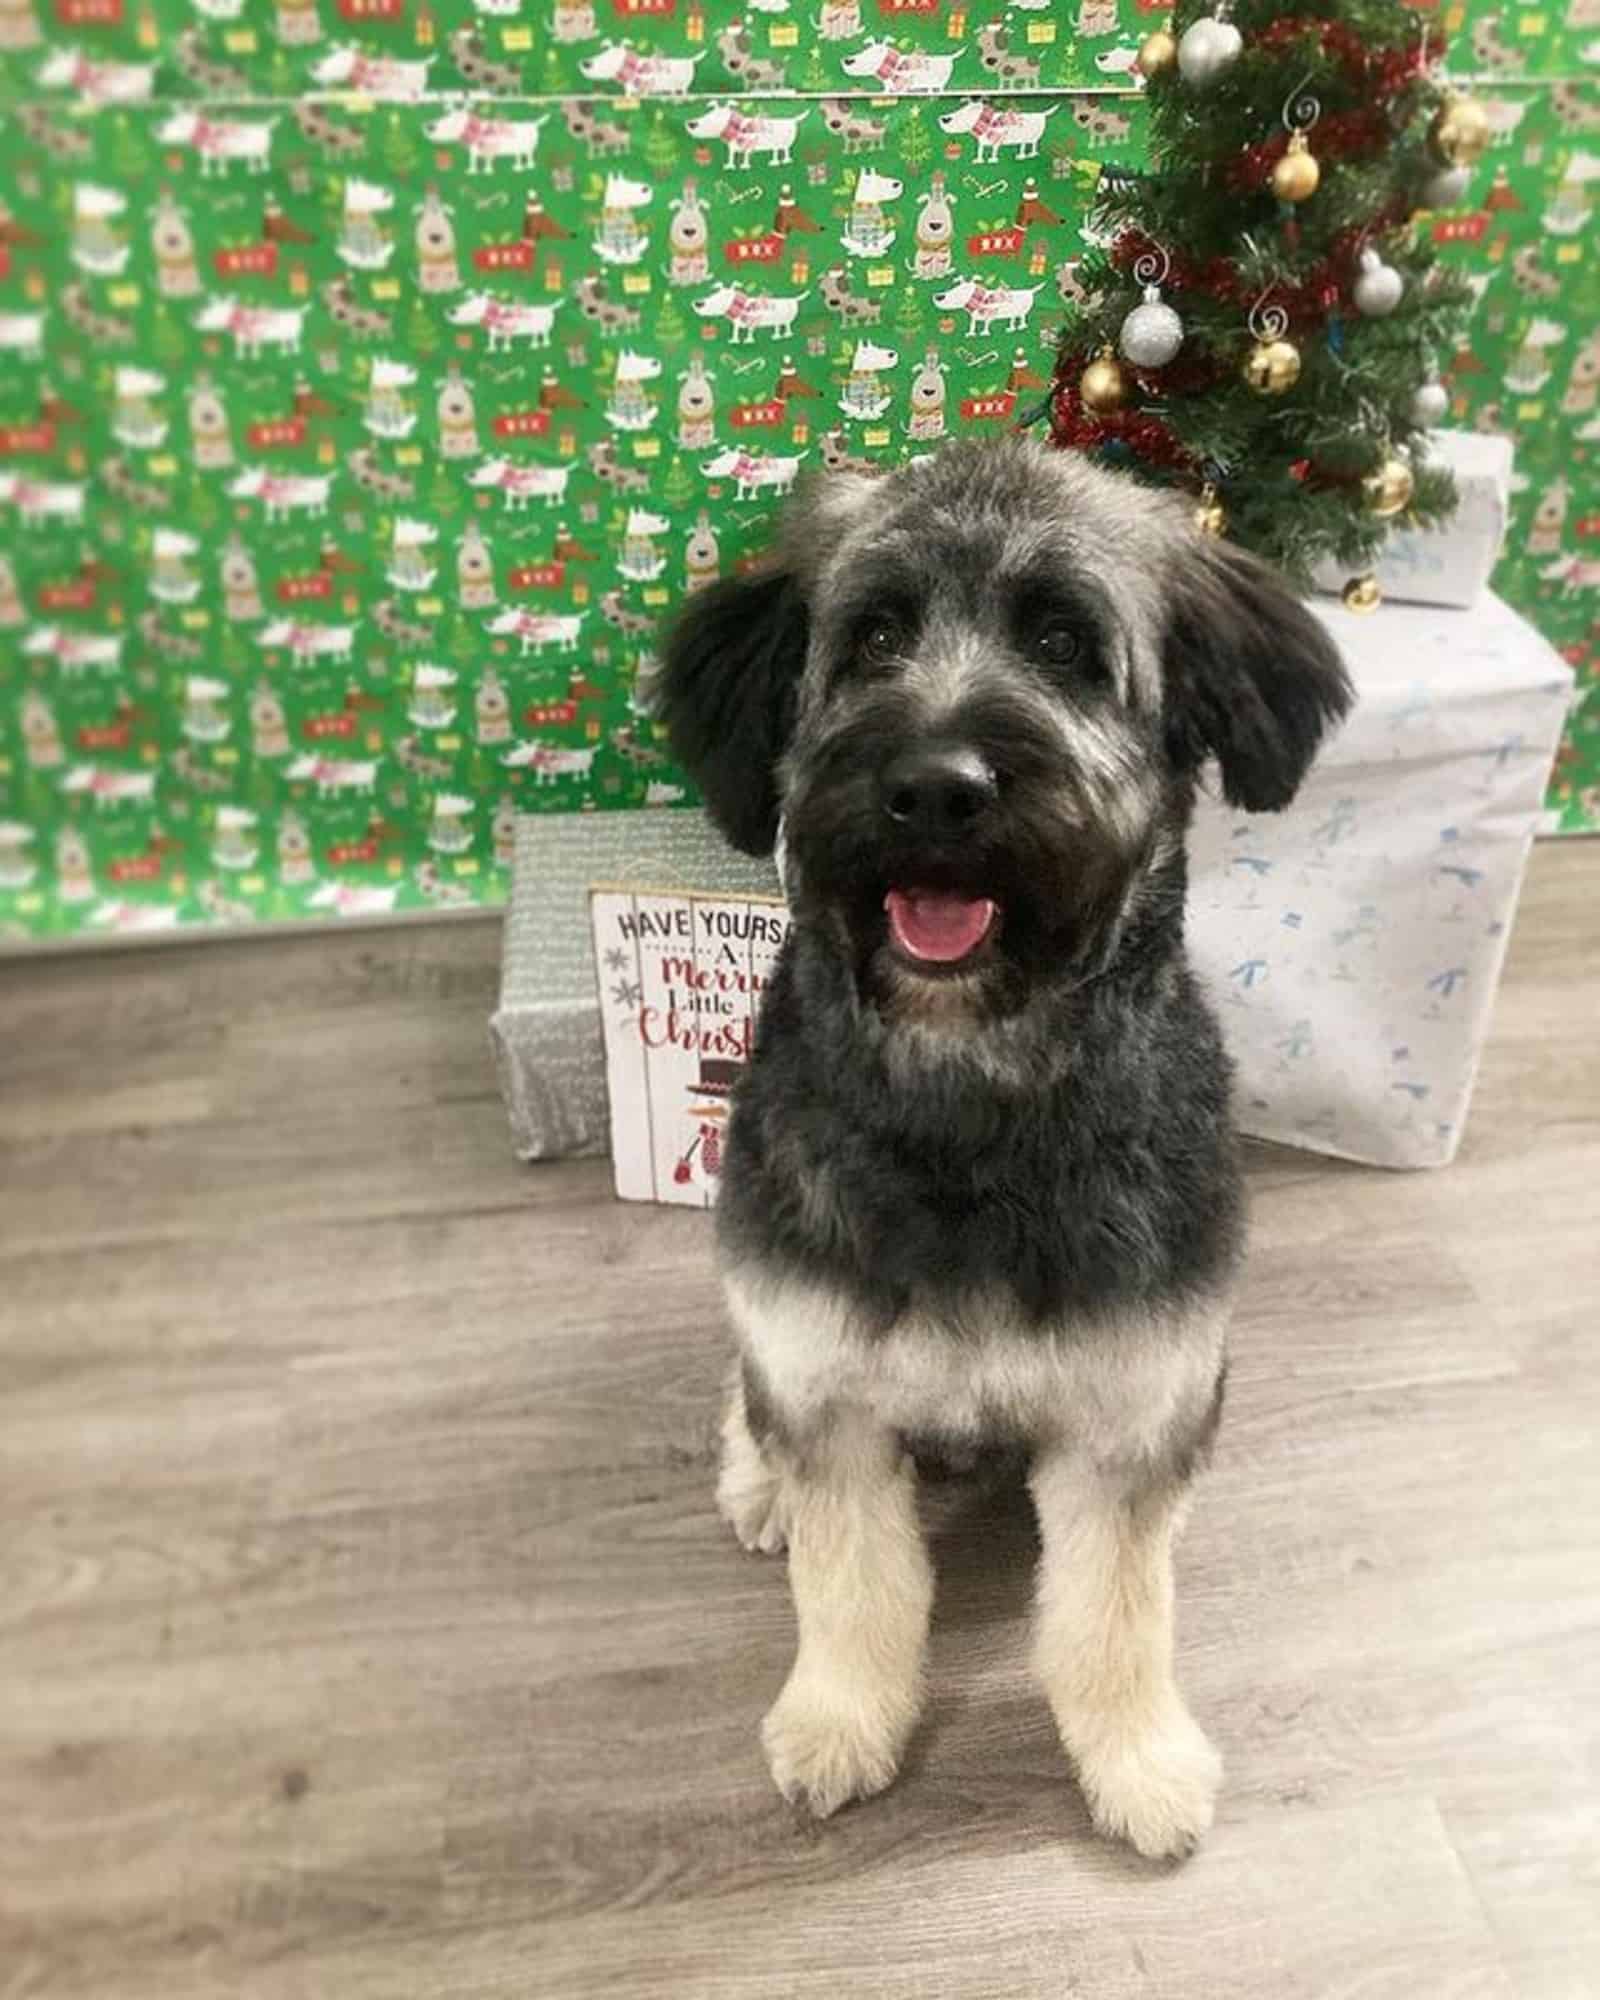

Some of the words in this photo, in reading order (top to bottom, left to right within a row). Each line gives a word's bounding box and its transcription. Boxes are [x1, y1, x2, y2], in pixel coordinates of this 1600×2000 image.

[618, 909, 691, 939] HAVE
[714, 943, 737, 965] A
[668, 988, 734, 1015] Little
